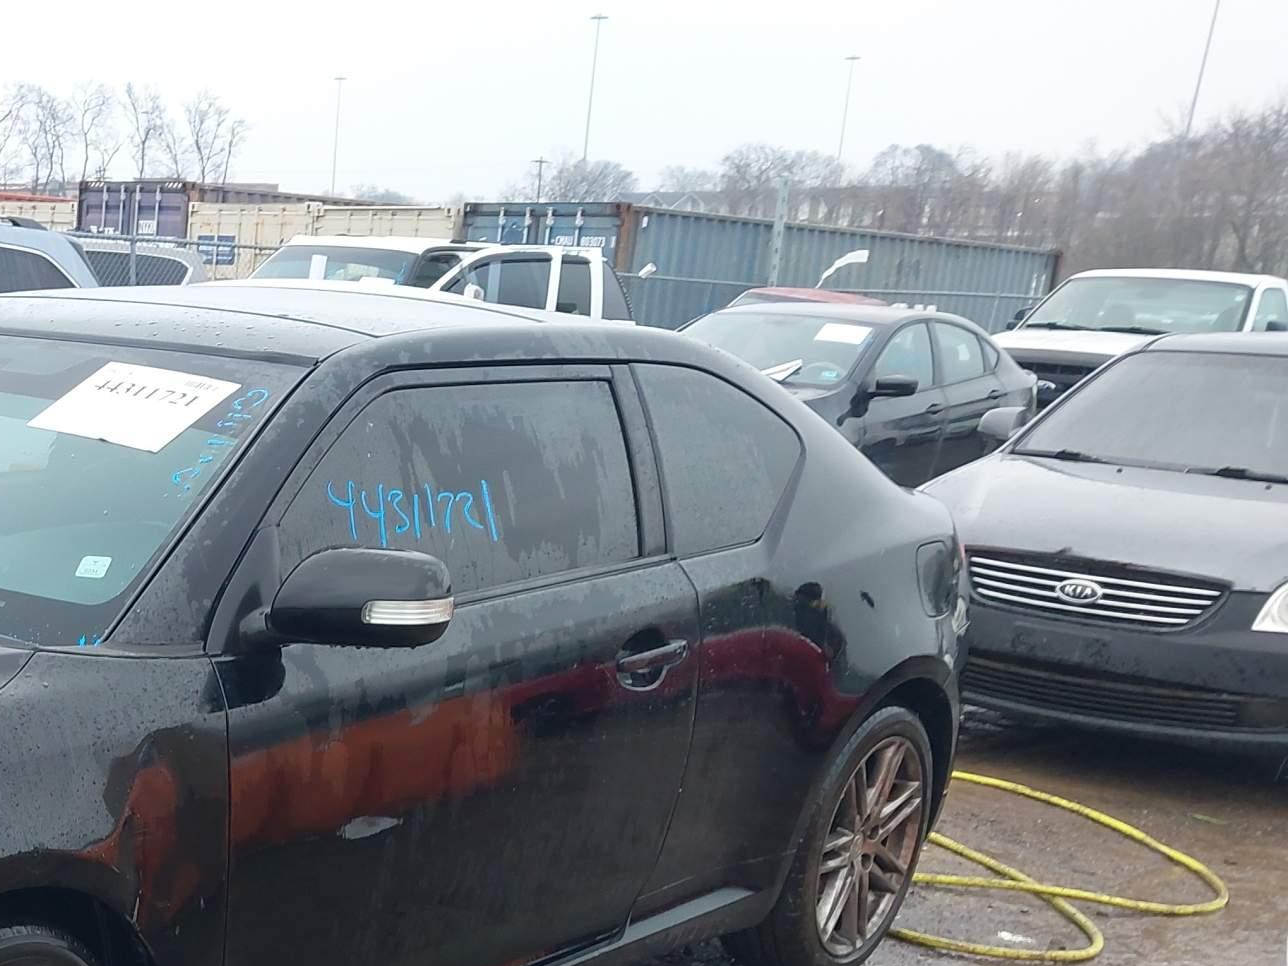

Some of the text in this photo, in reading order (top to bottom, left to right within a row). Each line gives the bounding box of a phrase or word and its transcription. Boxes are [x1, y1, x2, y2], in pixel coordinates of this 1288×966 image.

[94, 379, 200, 407] 44311721
[327, 479, 499, 548] 44311721
[1063, 584, 1093, 598] KIA
